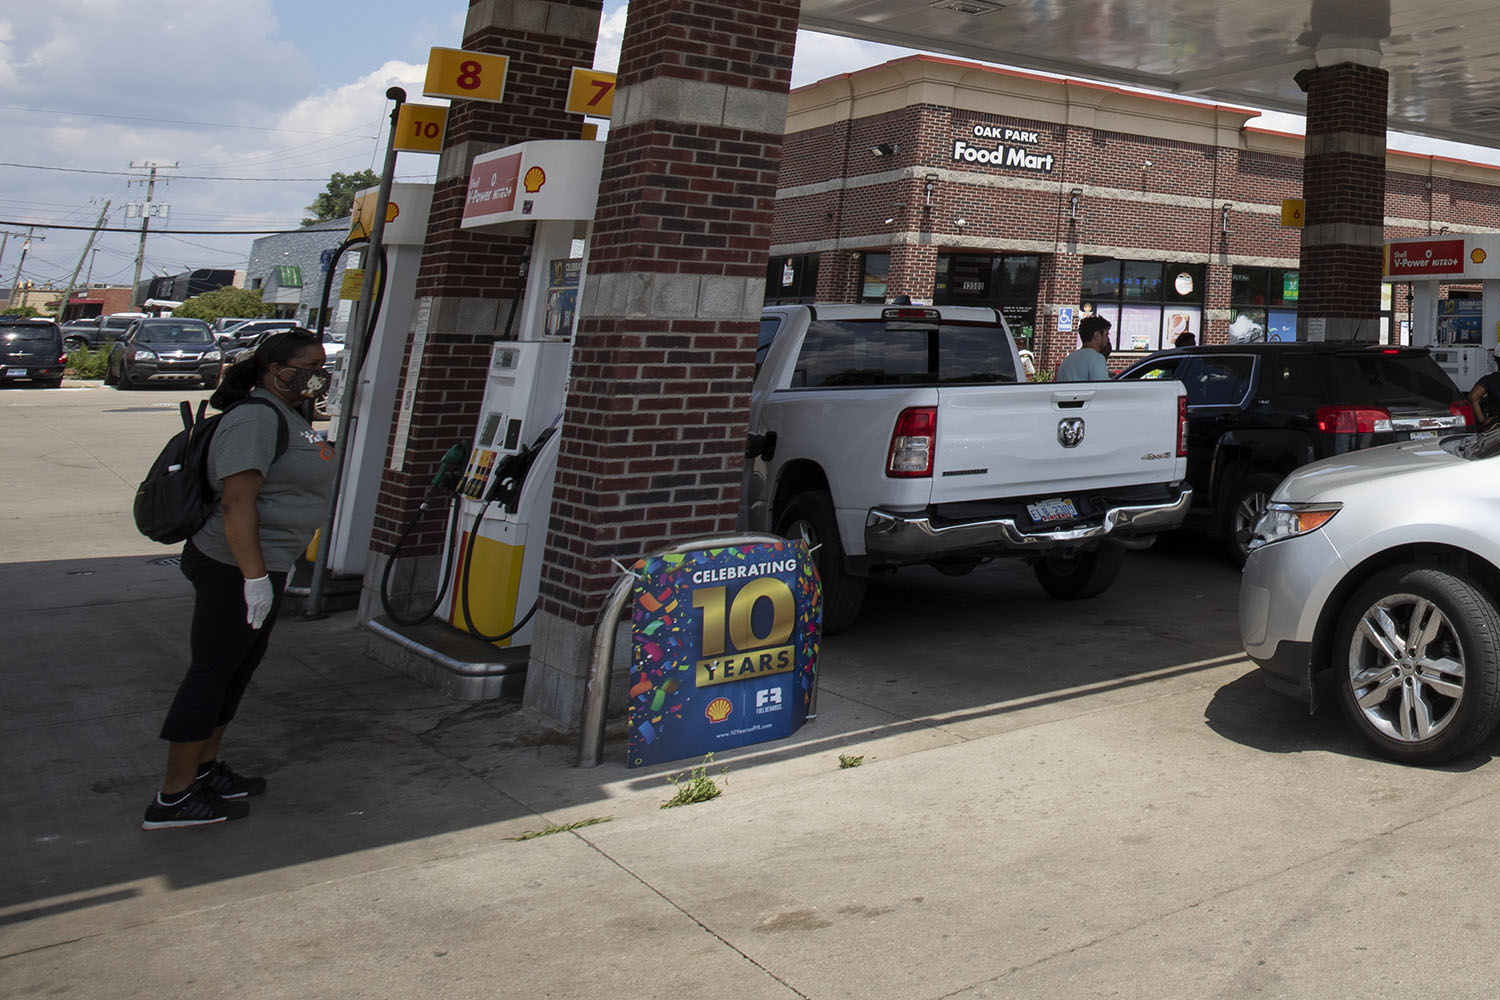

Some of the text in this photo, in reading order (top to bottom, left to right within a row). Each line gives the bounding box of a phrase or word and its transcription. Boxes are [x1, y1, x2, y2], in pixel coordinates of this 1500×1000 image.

[456, 60, 483, 91] 8
[586, 80, 615, 107] 7
[413, 120, 440, 139] 10
[973, 125, 1039, 143] OAK PARK
[953, 141, 1054, 170] Food Mart
[1293, 208, 1301, 219] 6
[1393, 250, 1407, 258] Shell
[1394, 258, 1458, 268] V-Power NITRO+
[1444, 300, 1455, 314] 10
[692, 558, 797, 584] CELEBRATING
[692, 576, 796, 657] 10
[703, 650, 790, 681] YEARS
